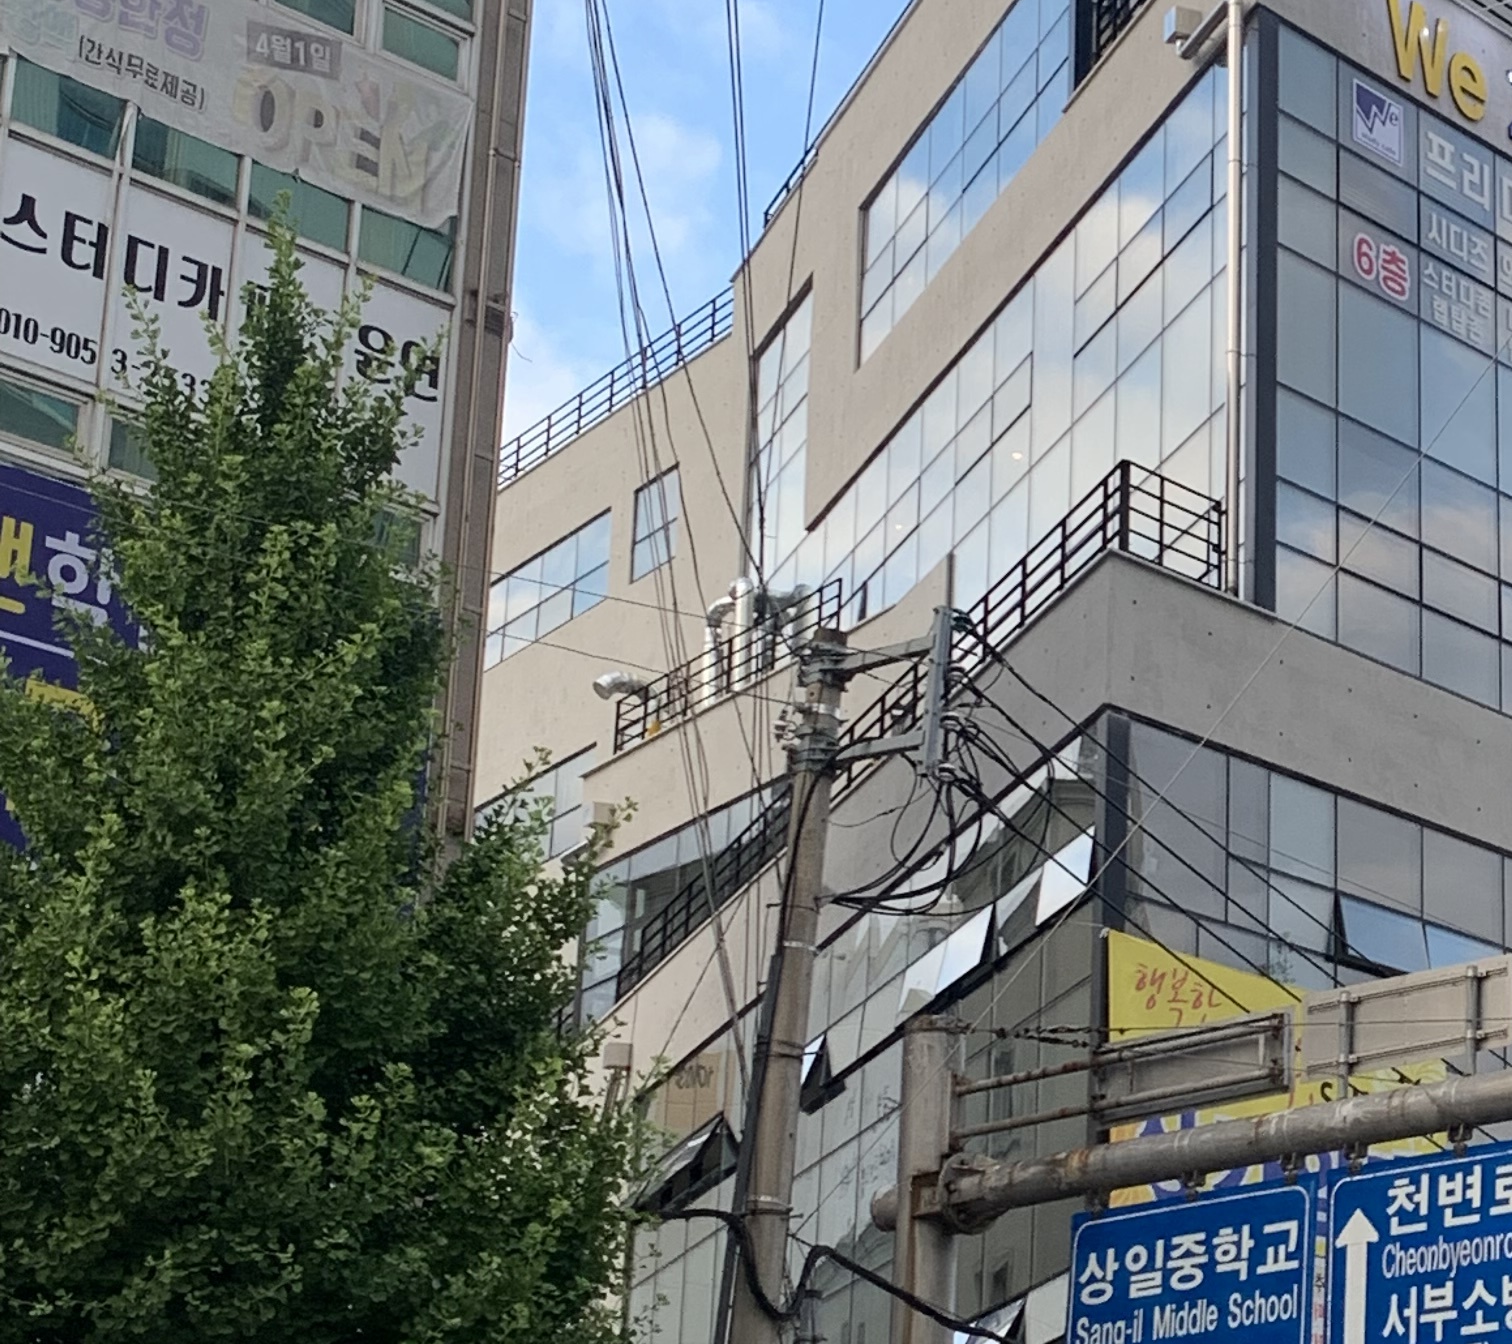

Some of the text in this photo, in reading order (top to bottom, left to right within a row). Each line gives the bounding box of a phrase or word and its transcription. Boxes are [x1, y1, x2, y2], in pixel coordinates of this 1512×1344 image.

[255, 33, 331, 72] 4월1일
[0, 193, 270, 323] 스터디카
[1354, 233, 1410, 302] 6층
[1428, 212, 1489, 274] 시디즈
[1135, 962, 1222, 1009] 행복한
[1078, 1220, 1300, 1307] 상일중학교
[1152, 1297, 1218, 1342] Middle
[1228, 1283, 1299, 1327] School
